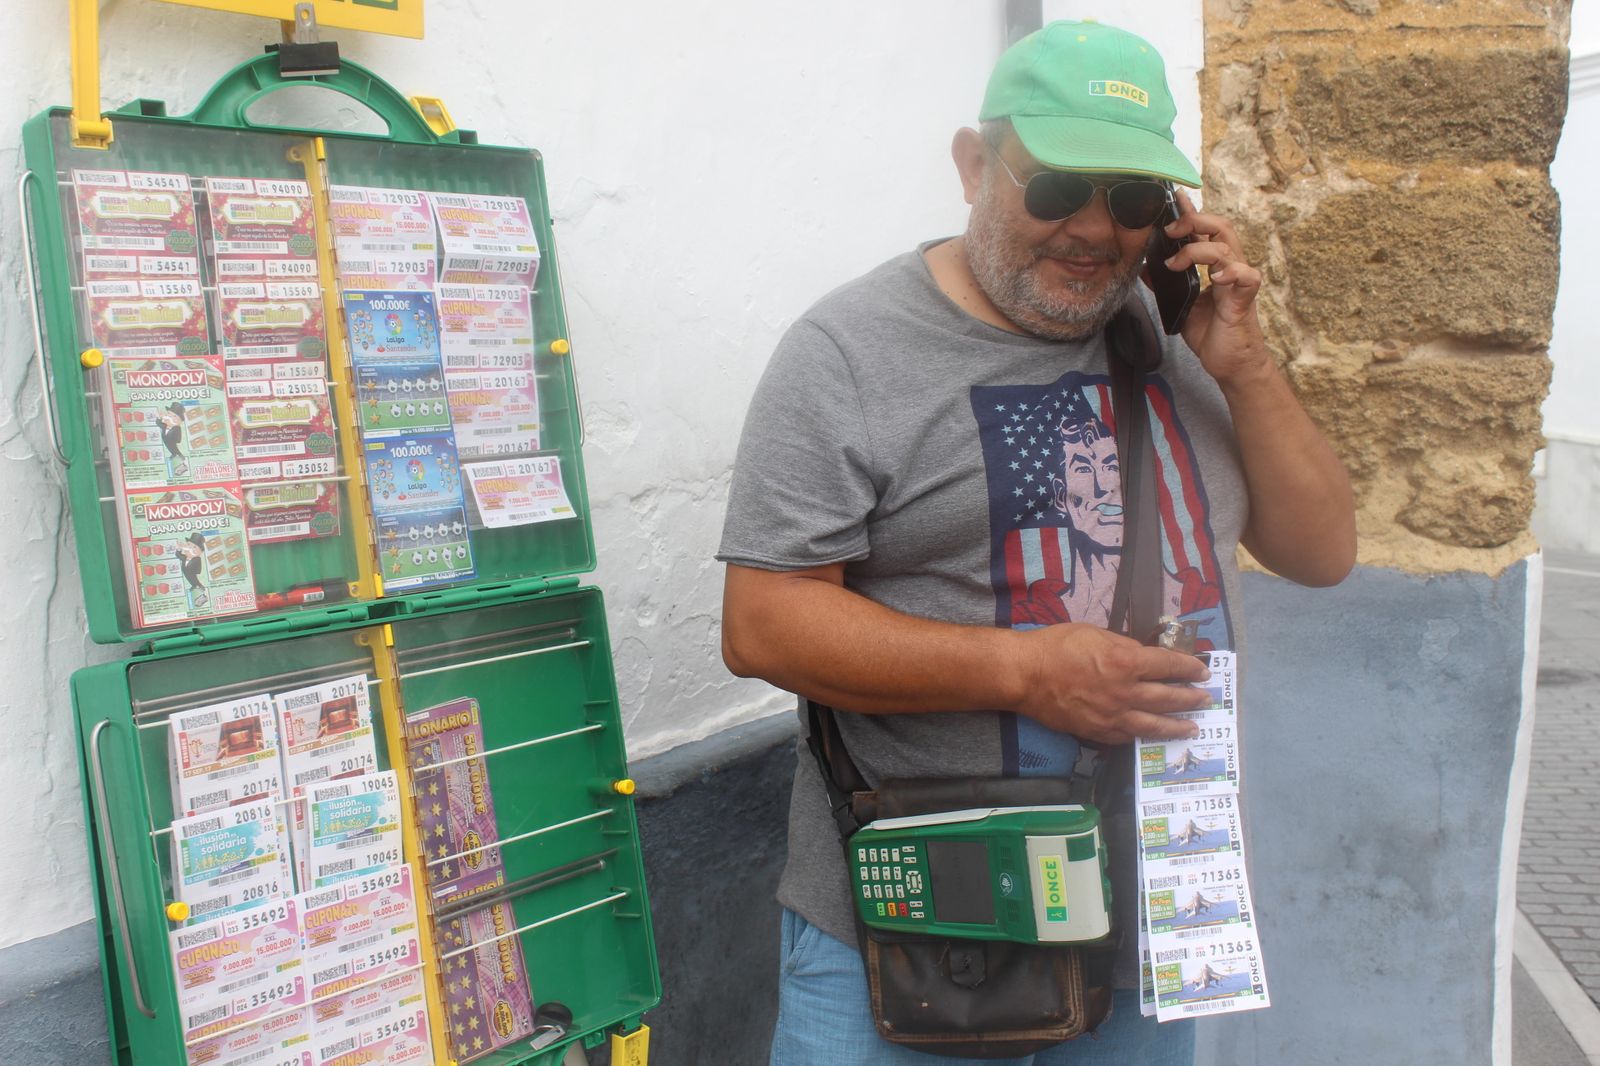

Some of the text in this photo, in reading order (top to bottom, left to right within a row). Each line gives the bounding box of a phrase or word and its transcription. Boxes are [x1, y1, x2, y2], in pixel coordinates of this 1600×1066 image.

[1110, 83, 1145, 103] ONCE
[147, 177, 181, 188] 54541
[272, 184, 302, 194] 94090
[382, 193, 419, 204] 72903
[483, 200, 517, 211] 72903
[157, 261, 190, 272] 54541
[281, 263, 311, 273] 94090
[390, 261, 426, 273] 72903
[496, 261, 529, 272] 72903
[159, 284, 193, 294] 15569
[283, 286, 312, 296] 15569
[488, 289, 520, 300] 72903
[369, 299, 411, 311] 100.000€
[386, 345, 417, 353] Santander
[493, 355, 523, 367] 72903
[129, 371, 204, 387] MONOPOLY
[495, 377, 526, 388] 20167
[288, 384, 319, 394] 25052
[390, 445, 433, 458] 100.000€
[298, 462, 328, 474] 25052
[518, 462, 550, 474] 20167
[408, 482, 427, 491] LaLiga
[407, 490, 440, 500] Santander
[148, 501, 223, 520] MONOPOLY
[332, 681, 364, 699] 20174
[232, 701, 269, 719] 20174
[255, 750, 276, 760] ONCE
[341, 753, 373, 772] 20174
[243, 777, 278, 796] 20174
[362, 776, 394, 793] 19045
[329, 798, 357, 810] ilusión
[330, 804, 372, 820] solidaria
[1195, 797, 1232, 812] 71365
[235, 804, 271, 824] 20816
[379, 823, 399, 834] ONCE
[1229, 812, 1237, 839] ONCE
[200, 831, 230, 844] ilusión
[201, 836, 247, 855] solidaria
[366, 849, 398, 866] 19045
[361, 872, 400, 893] 35492
[1047, 860, 1061, 903] ONCE
[1201, 868, 1240, 884] 71365
[242, 880, 278, 901] 20816
[1237, 883, 1246, 910] ONCE
[242, 906, 286, 930] 35492
[305, 903, 358, 930] CUPONAZO
[373, 902, 406, 918] 15.000.000
[255, 937, 292, 955] 15.000.000
[264, 935, 277, 943] XXL
[179, 939, 240, 970] CUPONAZO
[369, 944, 408, 967] 35492
[1210, 940, 1253, 956] 71365
[222, 956, 253, 971] 9.000.000
[1249, 955, 1259, 983] ONCE
[380, 974, 413, 991] 15.000.000
[251, 982, 293, 1007] 35492
[262, 1013, 299, 1032] 15.000.000
[376, 1016, 416, 1039] 35492
[388, 1046, 421, 1063] 15.000.000
